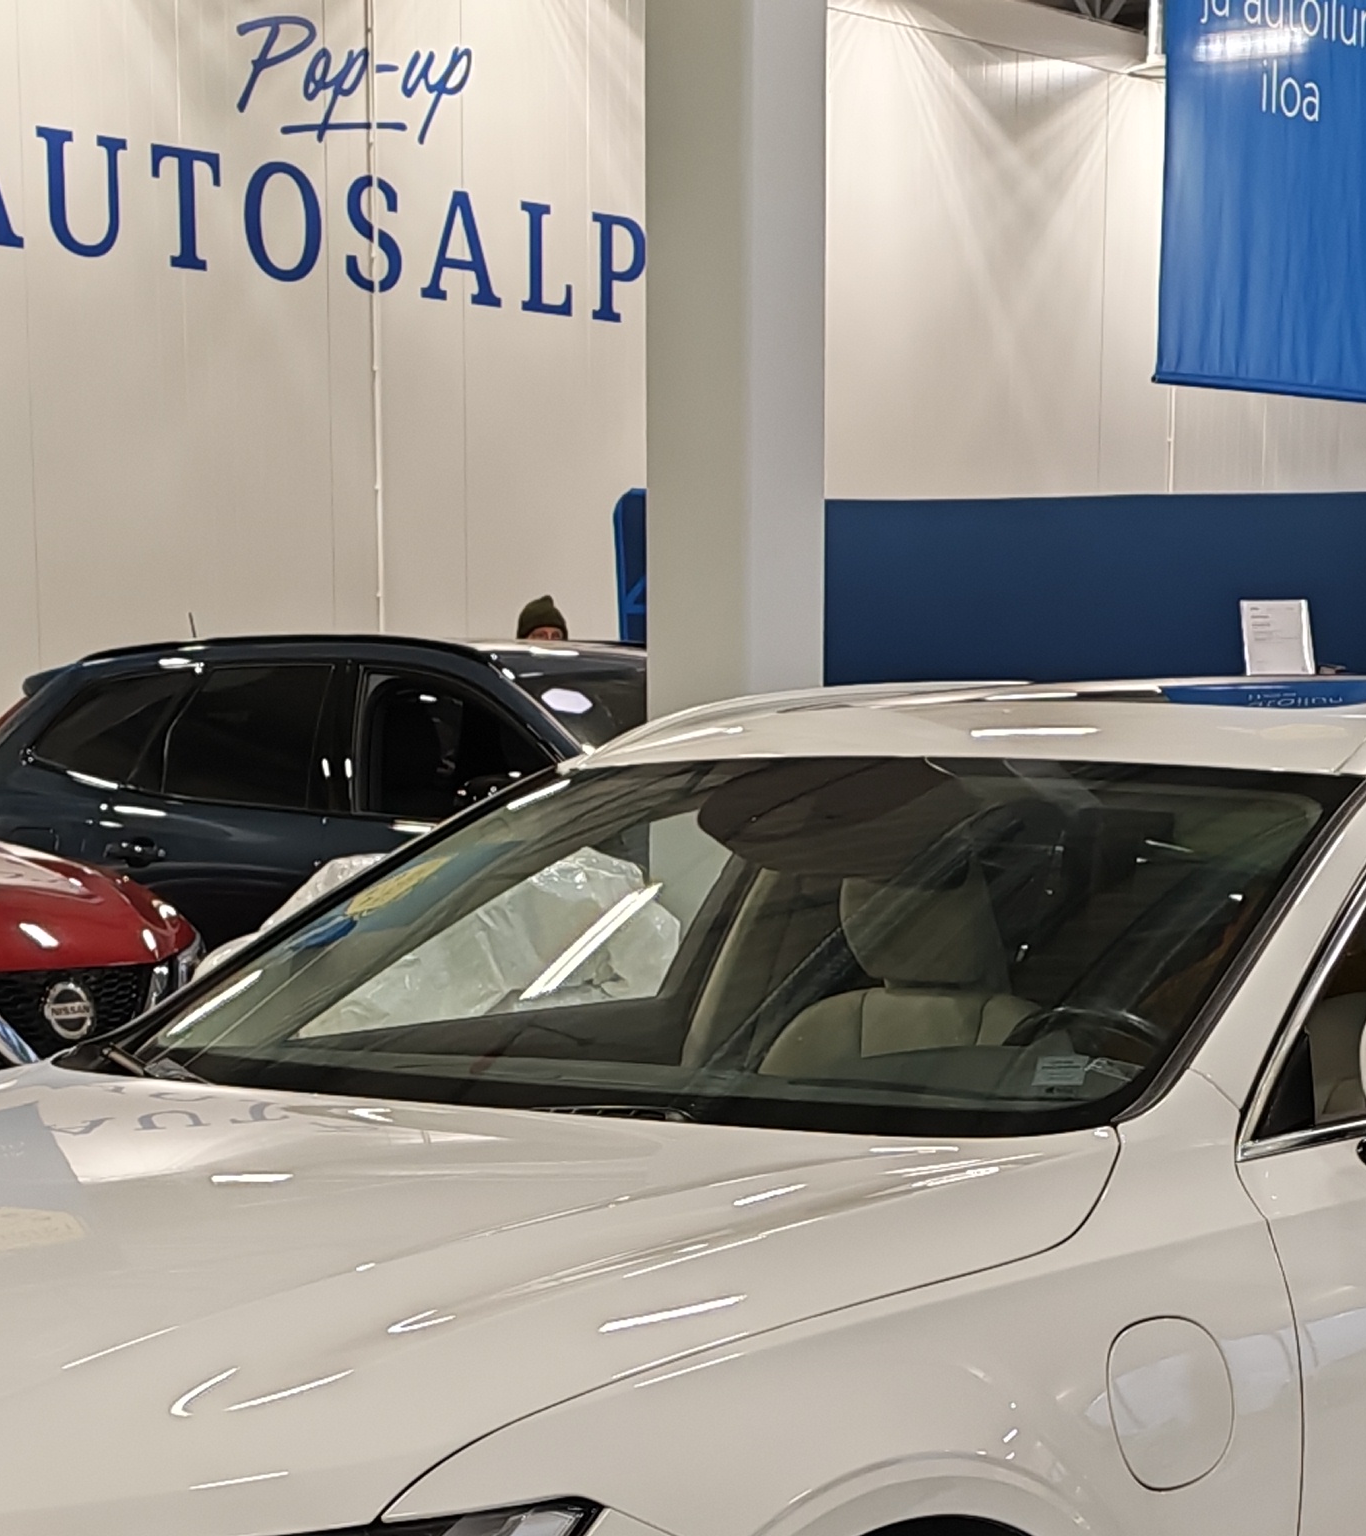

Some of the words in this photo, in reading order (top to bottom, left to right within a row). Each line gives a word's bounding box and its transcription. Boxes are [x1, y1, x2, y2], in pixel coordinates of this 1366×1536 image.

[236, 15, 473, 144] Pop-up
[1261, 59, 1320, 122] iloa
[51, 1005, 90, 1017] NISSAN
